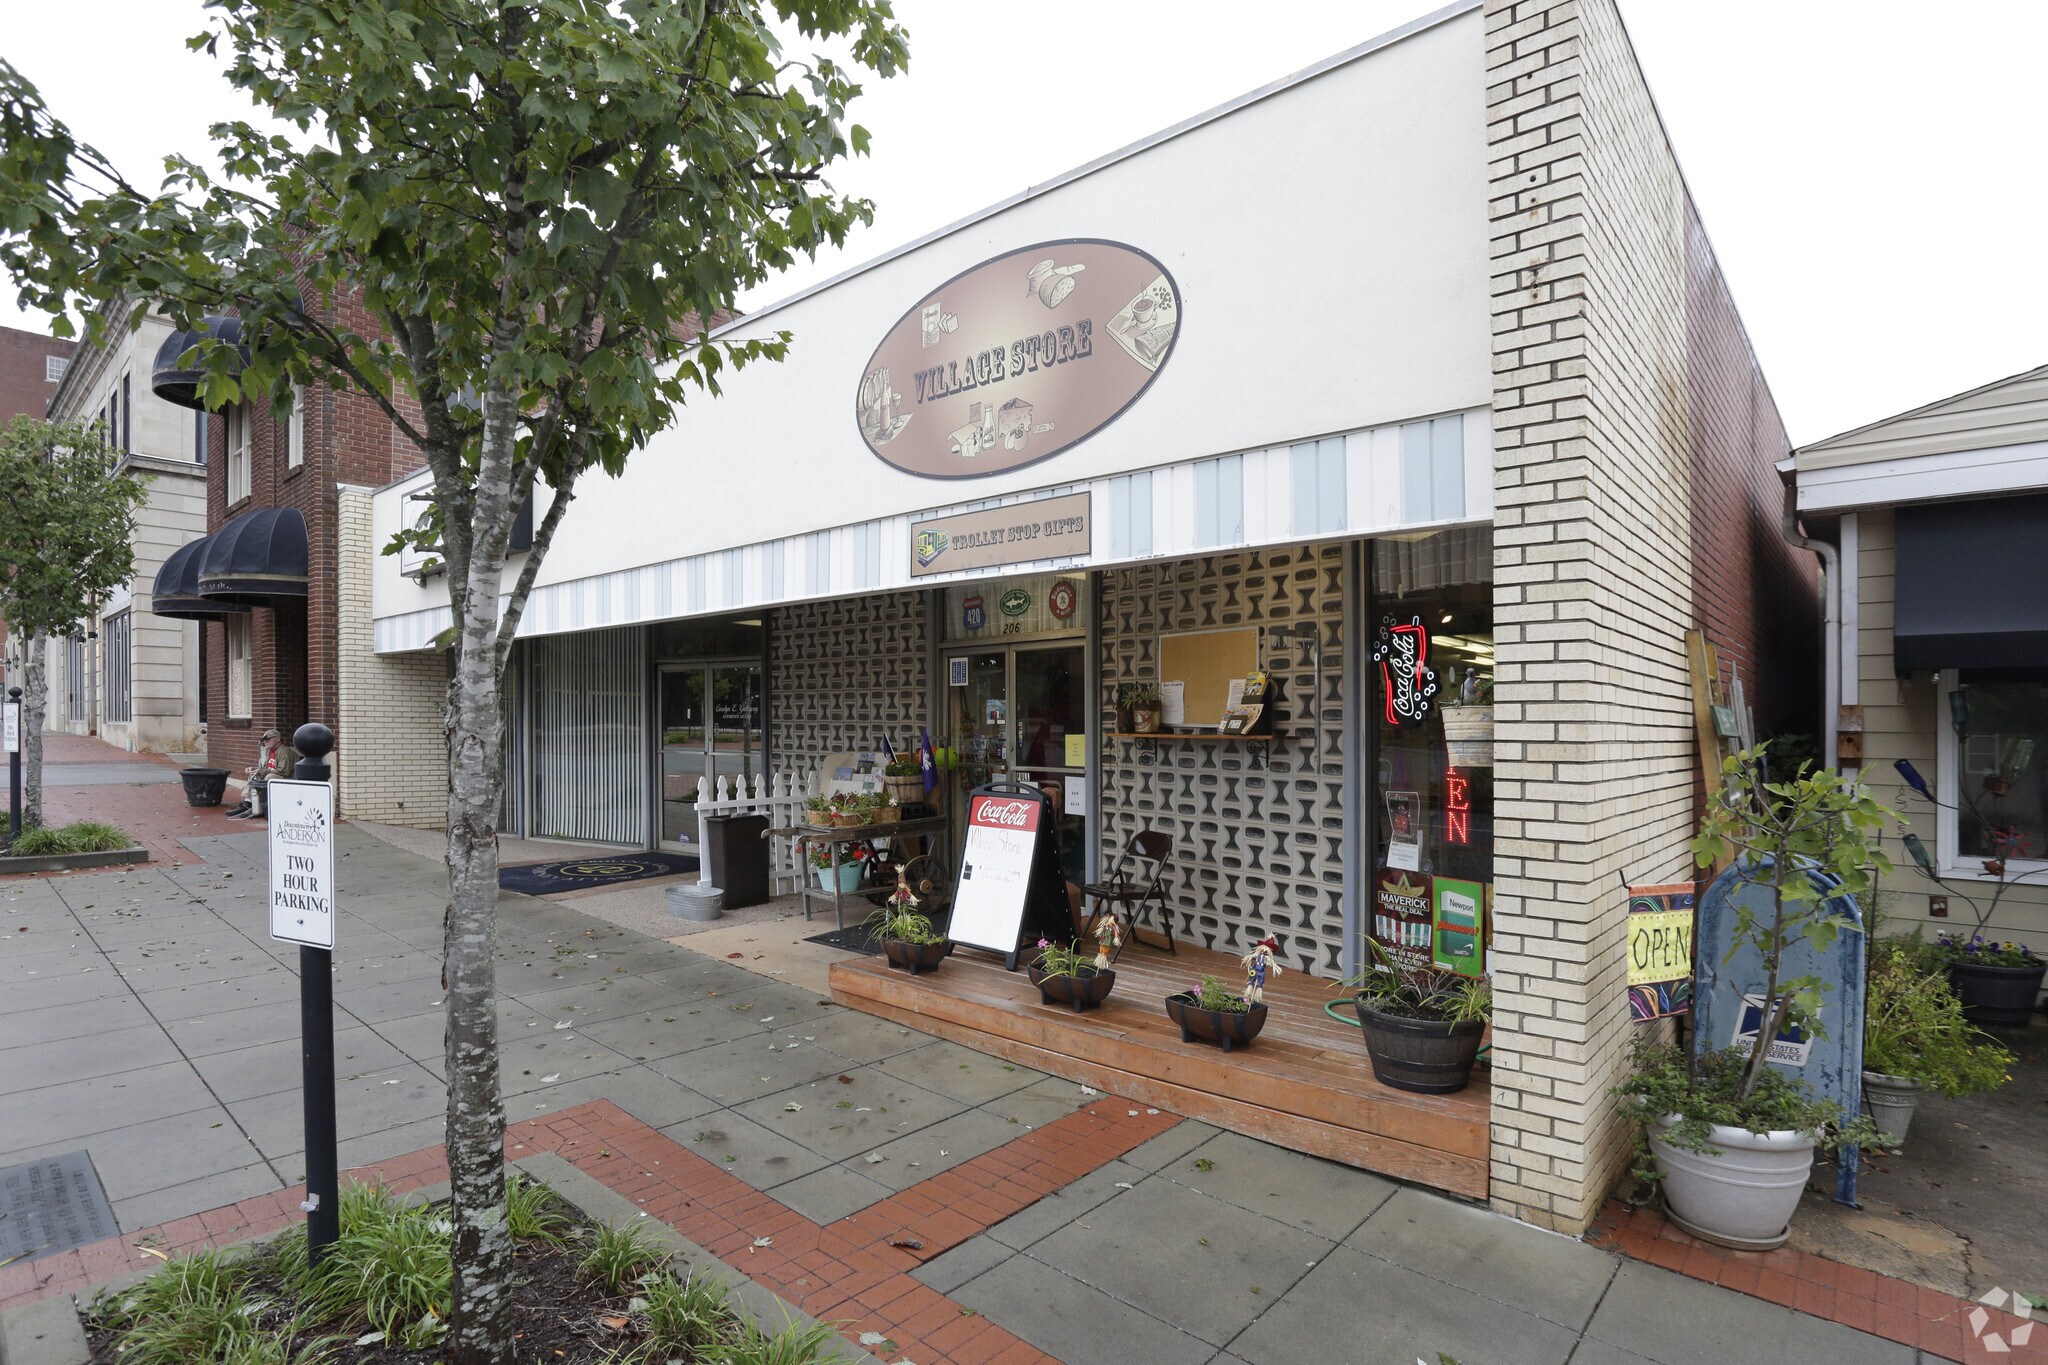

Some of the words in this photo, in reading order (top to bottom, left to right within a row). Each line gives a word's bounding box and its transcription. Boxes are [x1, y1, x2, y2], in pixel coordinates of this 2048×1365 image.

[913, 345, 1005, 405] VILLAGE
[1010, 319, 1092, 377] STORE
[952, 528, 1006, 550] TROLLEY
[1007, 523, 1041, 542] STOP
[1043, 516, 1084, 536] GIFTS
[967, 607, 981, 625] 420
[1003, 622, 1020, 634] 206
[977, 800, 1032, 826] Coca-Cola
[276, 823, 325, 843] ANDERSON
[287, 855, 314, 873] TWO
[283, 873, 318, 892] HOUR
[275, 891, 329, 914] PARKING
[1380, 893, 1427, 909] MAVERICK
[1449, 898, 1474, 913] Newport
[1395, 905, 1409, 914] REAL
[1409, 908, 1424, 916] DEAL
[1381, 945, 1397, 955] ORE
[1407, 951, 1430, 962] STORE
[1633, 925, 1689, 970] OPEN
[1767, 1051, 1802, 1062] SERVICE
[1770, 1043, 1800, 1053] STATES
